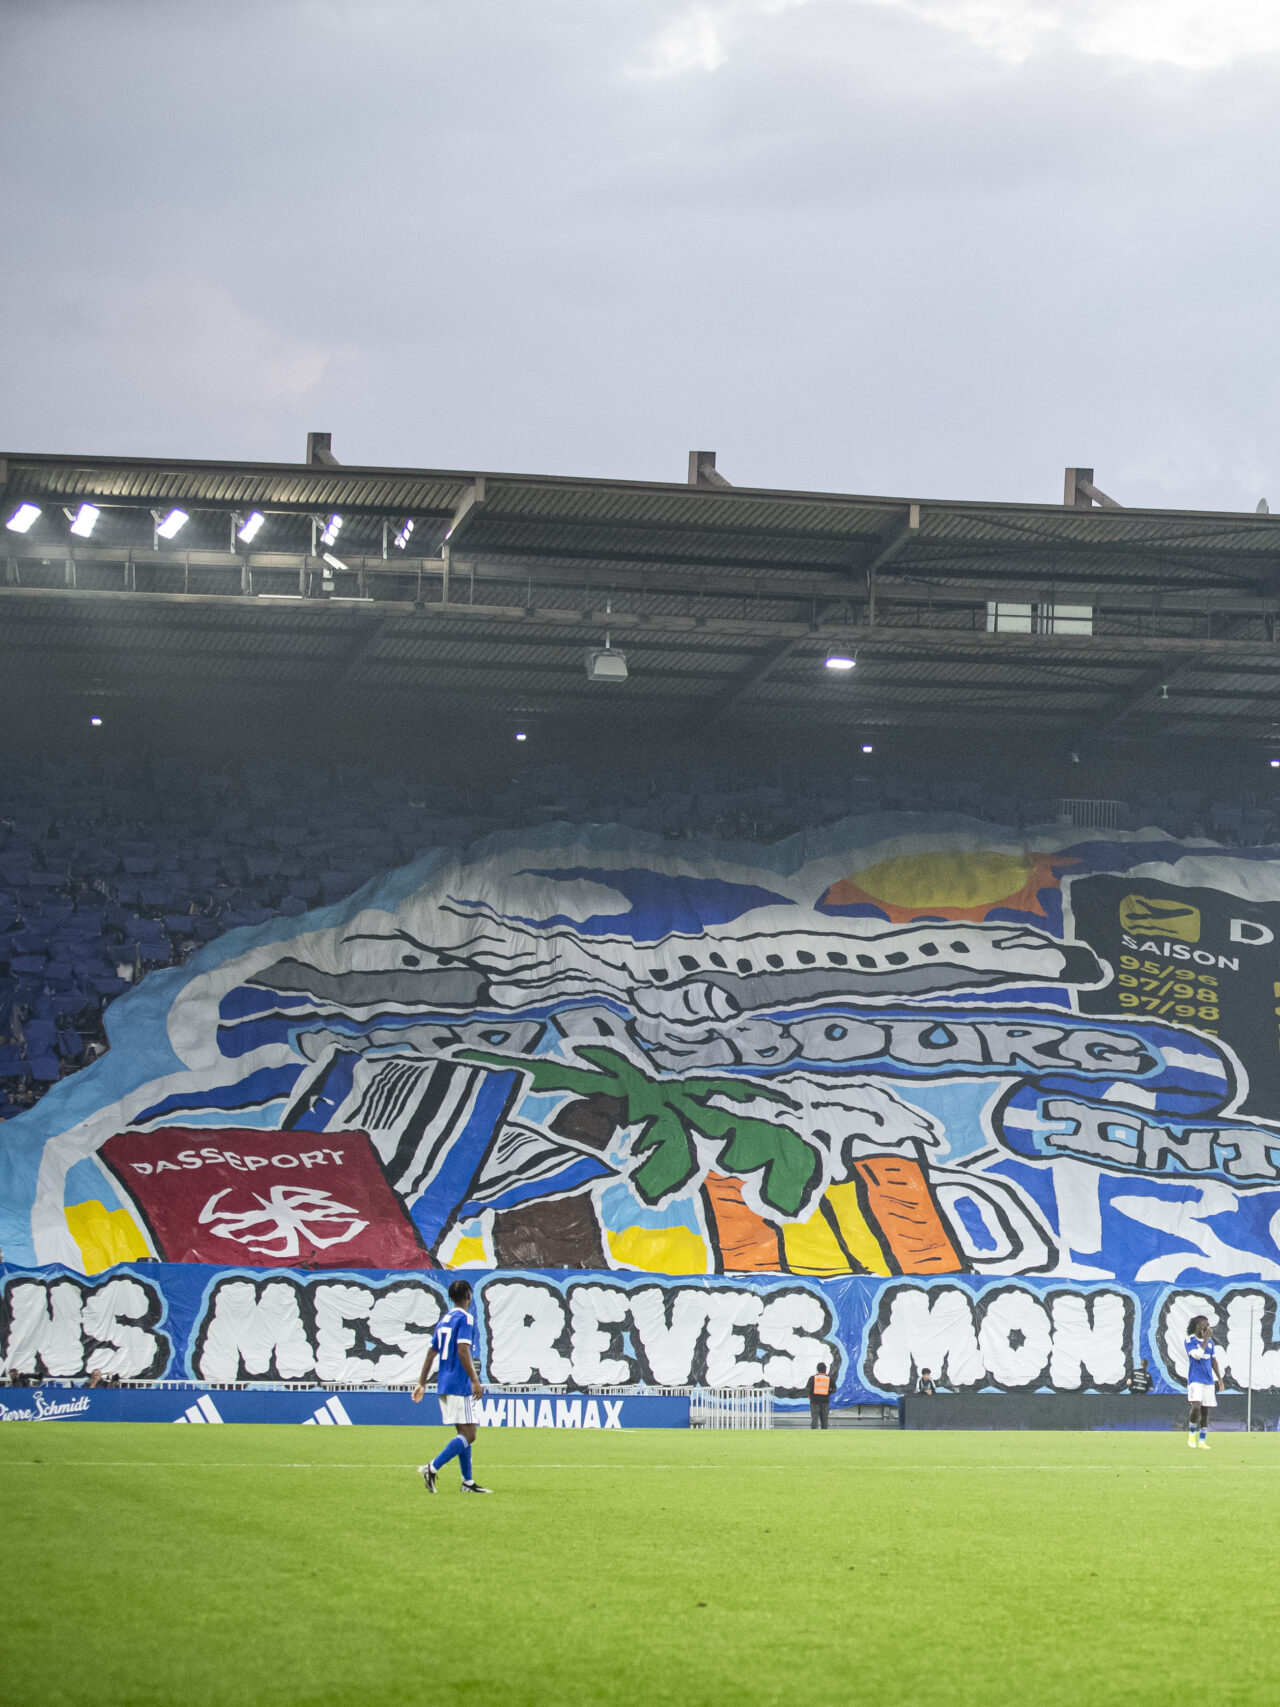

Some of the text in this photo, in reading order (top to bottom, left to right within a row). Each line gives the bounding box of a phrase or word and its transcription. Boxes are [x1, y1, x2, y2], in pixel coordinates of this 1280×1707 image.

[1121, 934, 1239, 971] SAISON
[1120, 955, 1218, 986] 95/96
[1118, 974, 1219, 1003] 97/98
[1118, 993, 1219, 1020] 97/98
[130, 1148, 345, 1175] PASSEPORT
[0, 1280, 158, 1379] NS
[200, 1283, 441, 1383] MES
[485, 1283, 833, 1388] REVES
[873, 1290, 1126, 1389] MON
[34, 1392, 91, 1419] Schmidt
[477, 1399, 624, 1428] WINAMAX
